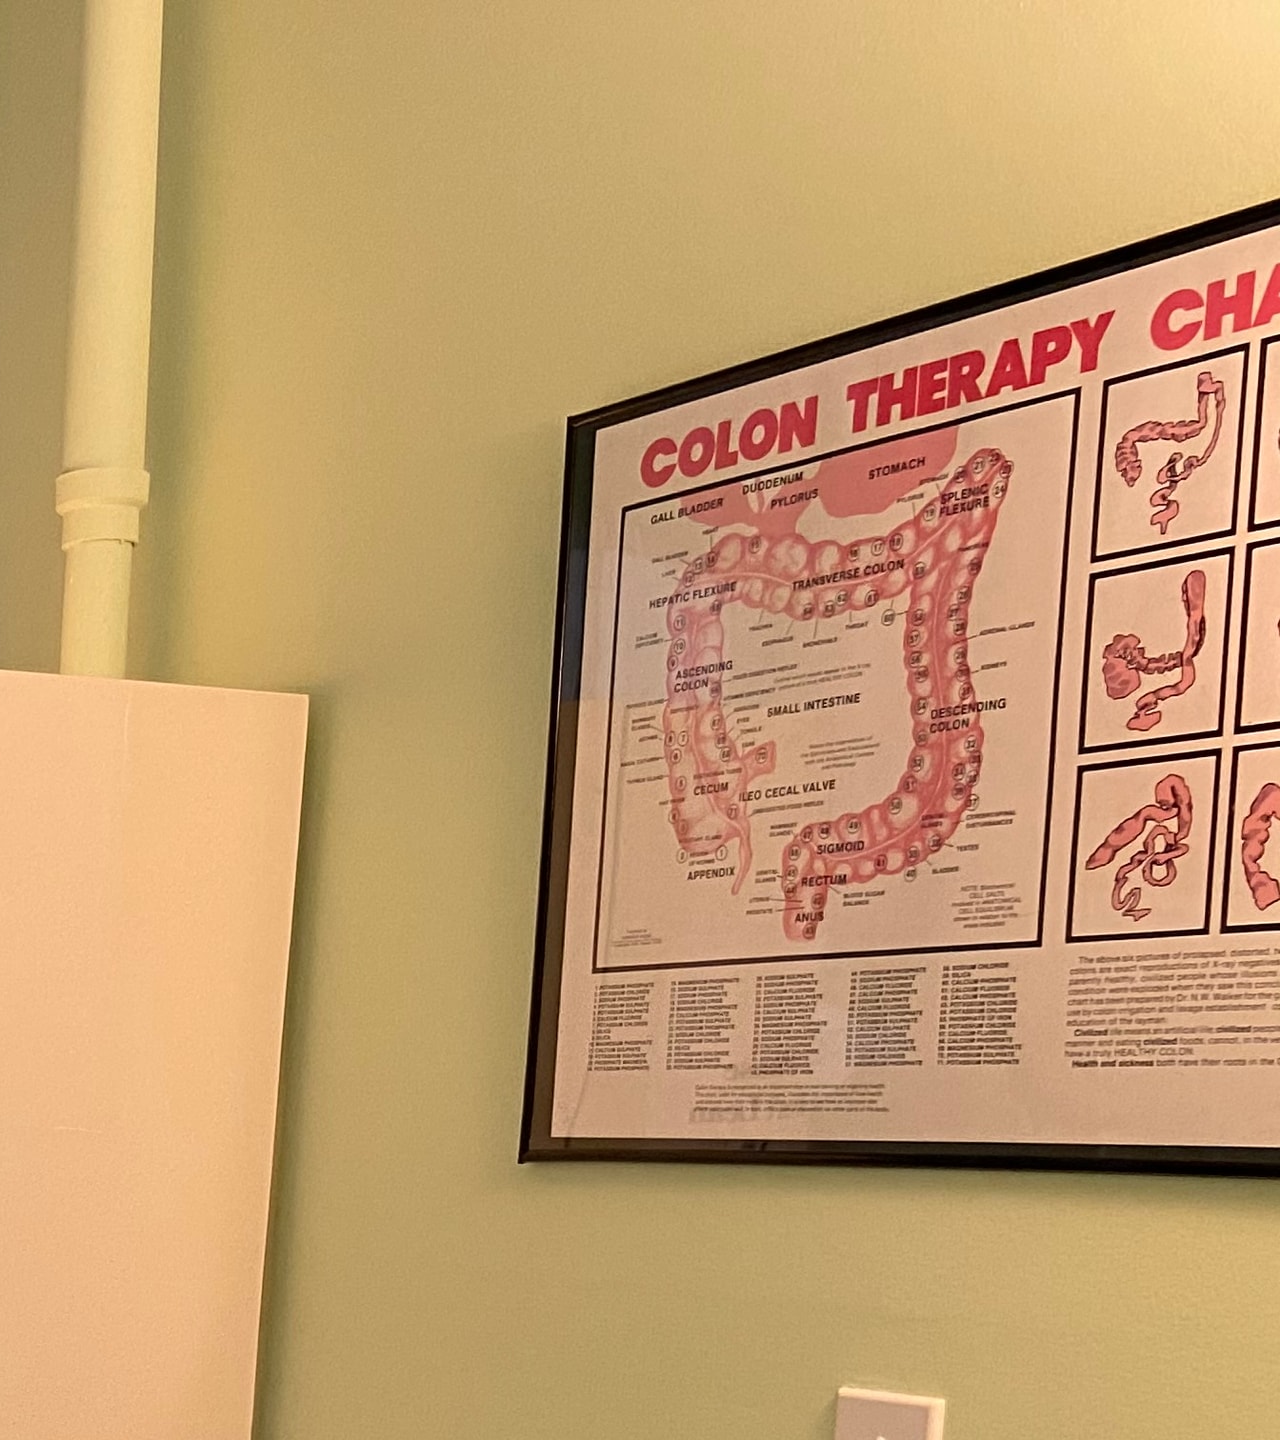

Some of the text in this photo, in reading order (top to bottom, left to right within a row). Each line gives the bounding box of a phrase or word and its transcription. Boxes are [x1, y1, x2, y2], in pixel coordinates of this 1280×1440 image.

[641, 395, 818, 487] COLON
[846, 310, 1115, 433] THERAPY
[868, 456, 926, 480] STOMACH
[742, 471, 804, 495] DUODENUM
[941, 483, 989, 505] SPLENIC
[770, 488, 819, 510] PYLORUS
[940, 496, 990, 517] FLEXURE
[651, 497, 725, 525] GALL BLADDER
[792, 559, 905, 592] TRANSVERSE COLON
[649, 581, 738, 609] HEPATIC FLEXURE
[675, 660, 733, 680] ASCENDING
[674, 677, 709, 693] COLON
[767, 703, 801, 718] SMALL
[803, 693, 861, 711] INTESTINE
[930, 698, 1007, 720] DESCENDING
[929, 718, 969, 734] COLON
[693, 782, 729, 796] CECUM
[739, 779, 836, 802] ILEO CECAL VALVE
[816, 840, 864, 855] SIGMOID
[687, 867, 735, 881] APPENDIX
[801, 874, 847, 887] RECTUM
[795, 911, 824, 923] ANUS
